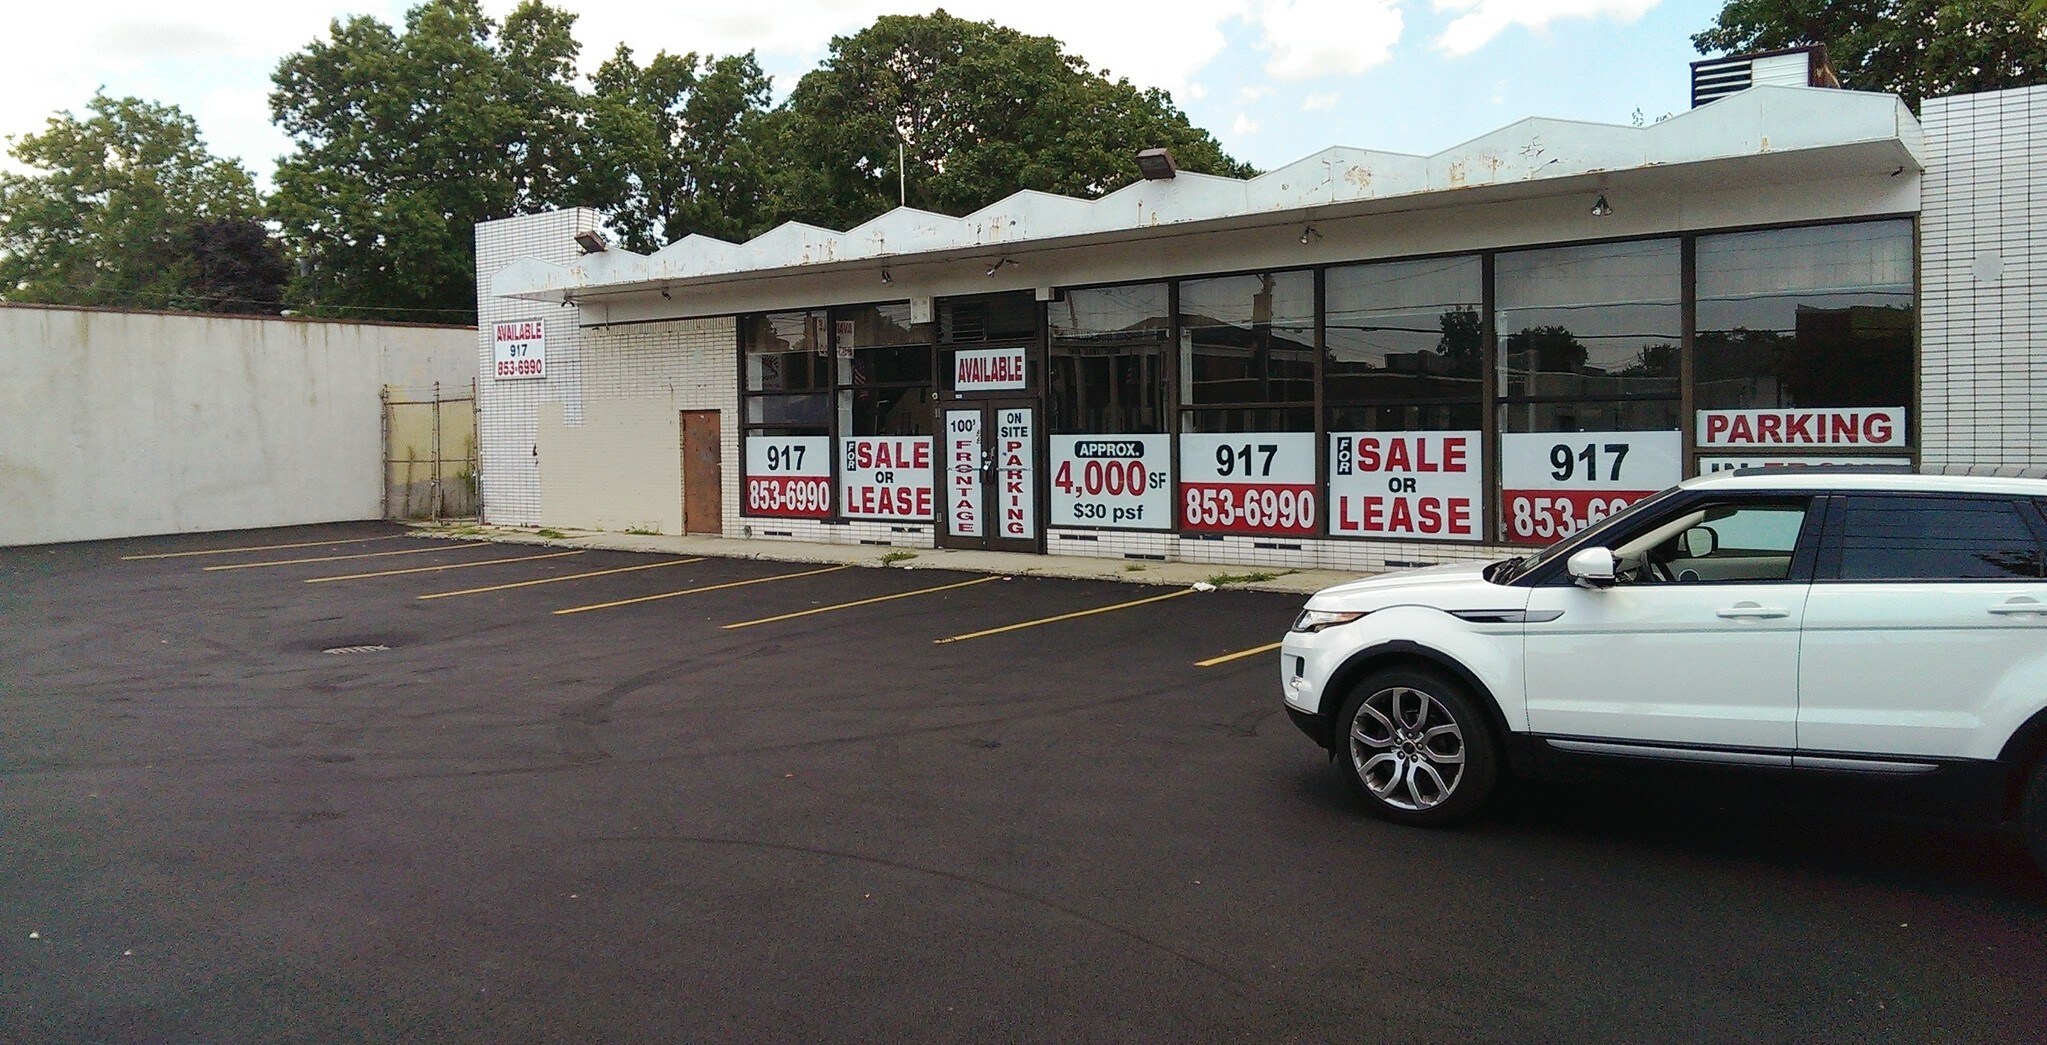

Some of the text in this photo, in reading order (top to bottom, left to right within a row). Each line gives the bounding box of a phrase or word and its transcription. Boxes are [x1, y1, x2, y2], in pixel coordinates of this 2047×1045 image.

[497, 323, 542, 341] AVAILABLE
[510, 344, 527, 357] 917
[497, 359, 542, 375] 853-6990
[957, 355, 1023, 383] AVAILABLE
[1001, 426, 1029, 438] SITE
[1006, 412, 1022, 424] ON
[1706, 412, 1893, 444] PARKING
[767, 445, 806, 471] 917
[847, 441, 930, 470] FOR SALE
[1079, 443, 1140, 457] APPROX.
[1215, 444, 1279, 477] 917
[1337, 437, 1467, 473] FOR SALE
[1549, 443, 1630, 482] 917
[875, 471, 894, 484] OR
[955, 440, 974, 532] FRONTAGE
[1006, 441, 1025, 534] PARKING
[1054, 460, 1167, 498] 4,000 SF
[1387, 476, 1417, 493] OR
[749, 480, 830, 511] 853-6990
[847, 486, 932, 516] LEASE
[1186, 488, 1315, 529] 853-6990
[1073, 503, 1144, 523] $30 psf
[1339, 495, 1471, 534] LEASE
